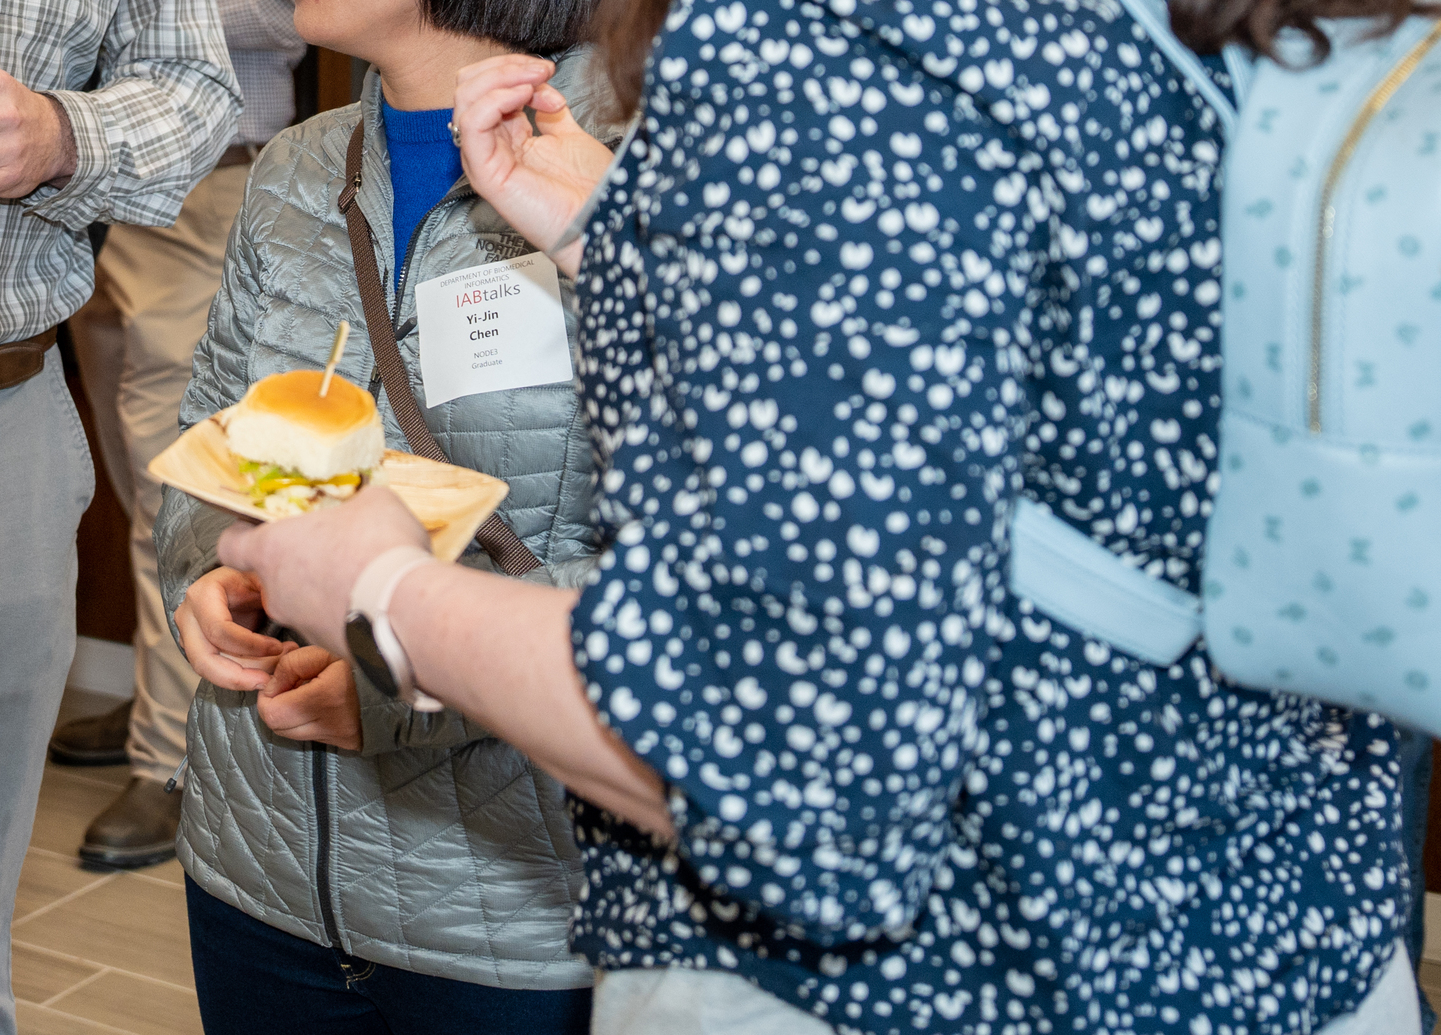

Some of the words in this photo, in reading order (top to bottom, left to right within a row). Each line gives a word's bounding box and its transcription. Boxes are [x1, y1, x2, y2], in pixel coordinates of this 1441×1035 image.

[500, 234, 525, 248] THE
[476, 239, 522, 258] NORTH
[440, 271, 482, 288] DEPARTMENT
[482, 269, 493, 277] OF
[494, 259, 534, 273] BIOMEDICAL
[464, 274, 510, 289] INFORMATICS
[456, 283, 521, 308] IABtalks
[466, 310, 499, 324] Yi-Jin
[469, 328, 499, 341] Chen
[473, 348, 498, 358] NODE3
[471, 359, 503, 369] Graduate
